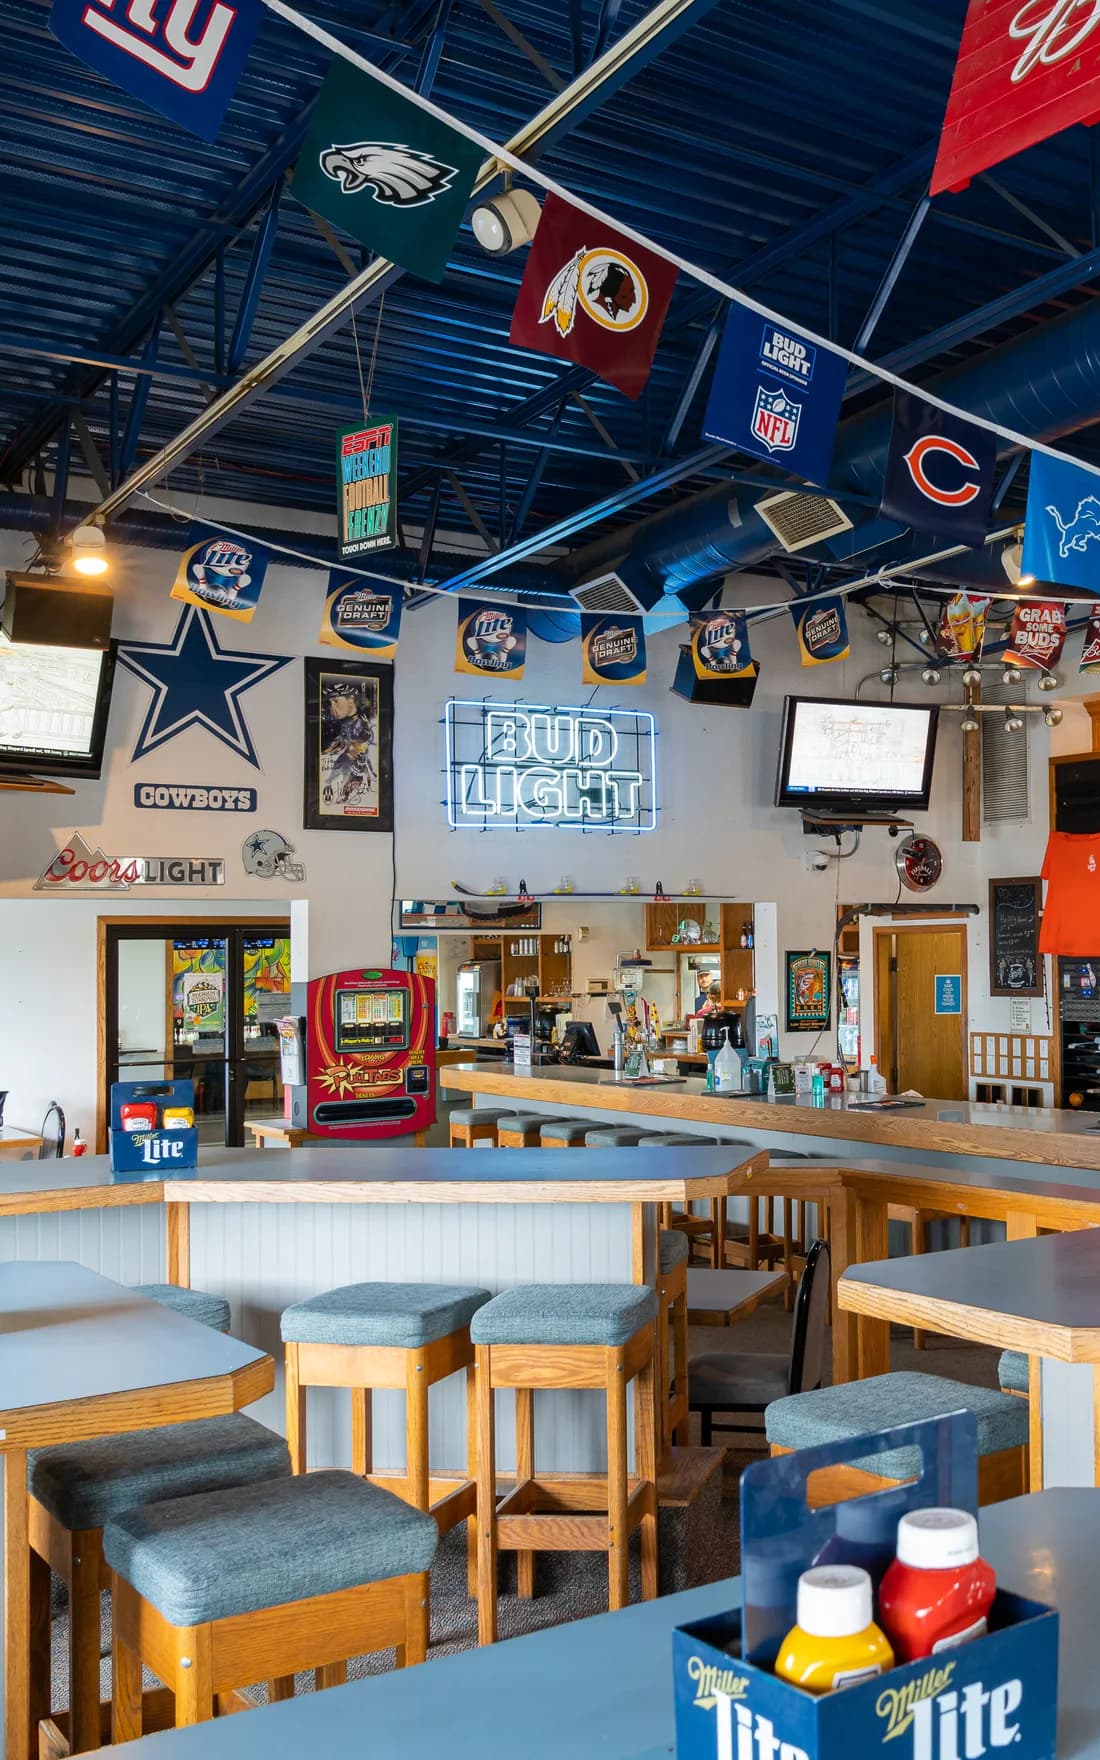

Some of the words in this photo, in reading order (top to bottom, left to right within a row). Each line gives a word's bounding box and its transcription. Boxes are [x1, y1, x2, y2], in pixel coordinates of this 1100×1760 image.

[772, 331, 806, 359] BUD
[763, 342, 811, 376] LIGHT
[757, 410, 790, 444] NFL
[342, 424, 393, 457] ESPN
[342, 446, 390, 484] WEEKEND
[343, 474, 390, 543] FOOTBALL
[348, 503, 389, 541] FRENZY
[203, 551, 253, 567] Lite
[342, 544, 358, 555] TOUCH
[360, 541, 376, 552] DOWN
[189, 583, 241, 610] Bowling
[336, 603, 392, 613] GENUINE
[340, 611, 385, 620] DRAFT
[475, 617, 513, 637] Lite
[805, 615, 840, 639] GENUINE
[1019, 608, 1062, 623] GRAB
[707, 622, 735, 646] Lite
[811, 624, 837, 642] DRAFT
[1015, 631, 1060, 647] BUDS
[1026, 623, 1054, 633] SOME
[592, 637, 638, 653] GENUINE
[599, 644, 632, 658] DRAFT
[468, 655, 512, 670] Bowling
[488, 711, 617, 766] BUD
[140, 786, 251, 810] COWBOYS
[461, 765, 642, 818] LIGHT
[44, 848, 141, 883] Coors
[144, 861, 222, 883] LIGHT
[141, 1139, 184, 1164] Lite
[687, 1655, 750, 1711] Miller
[875, 1660, 956, 1744] Miller
[908, 1678, 1022, 1760] Lite
